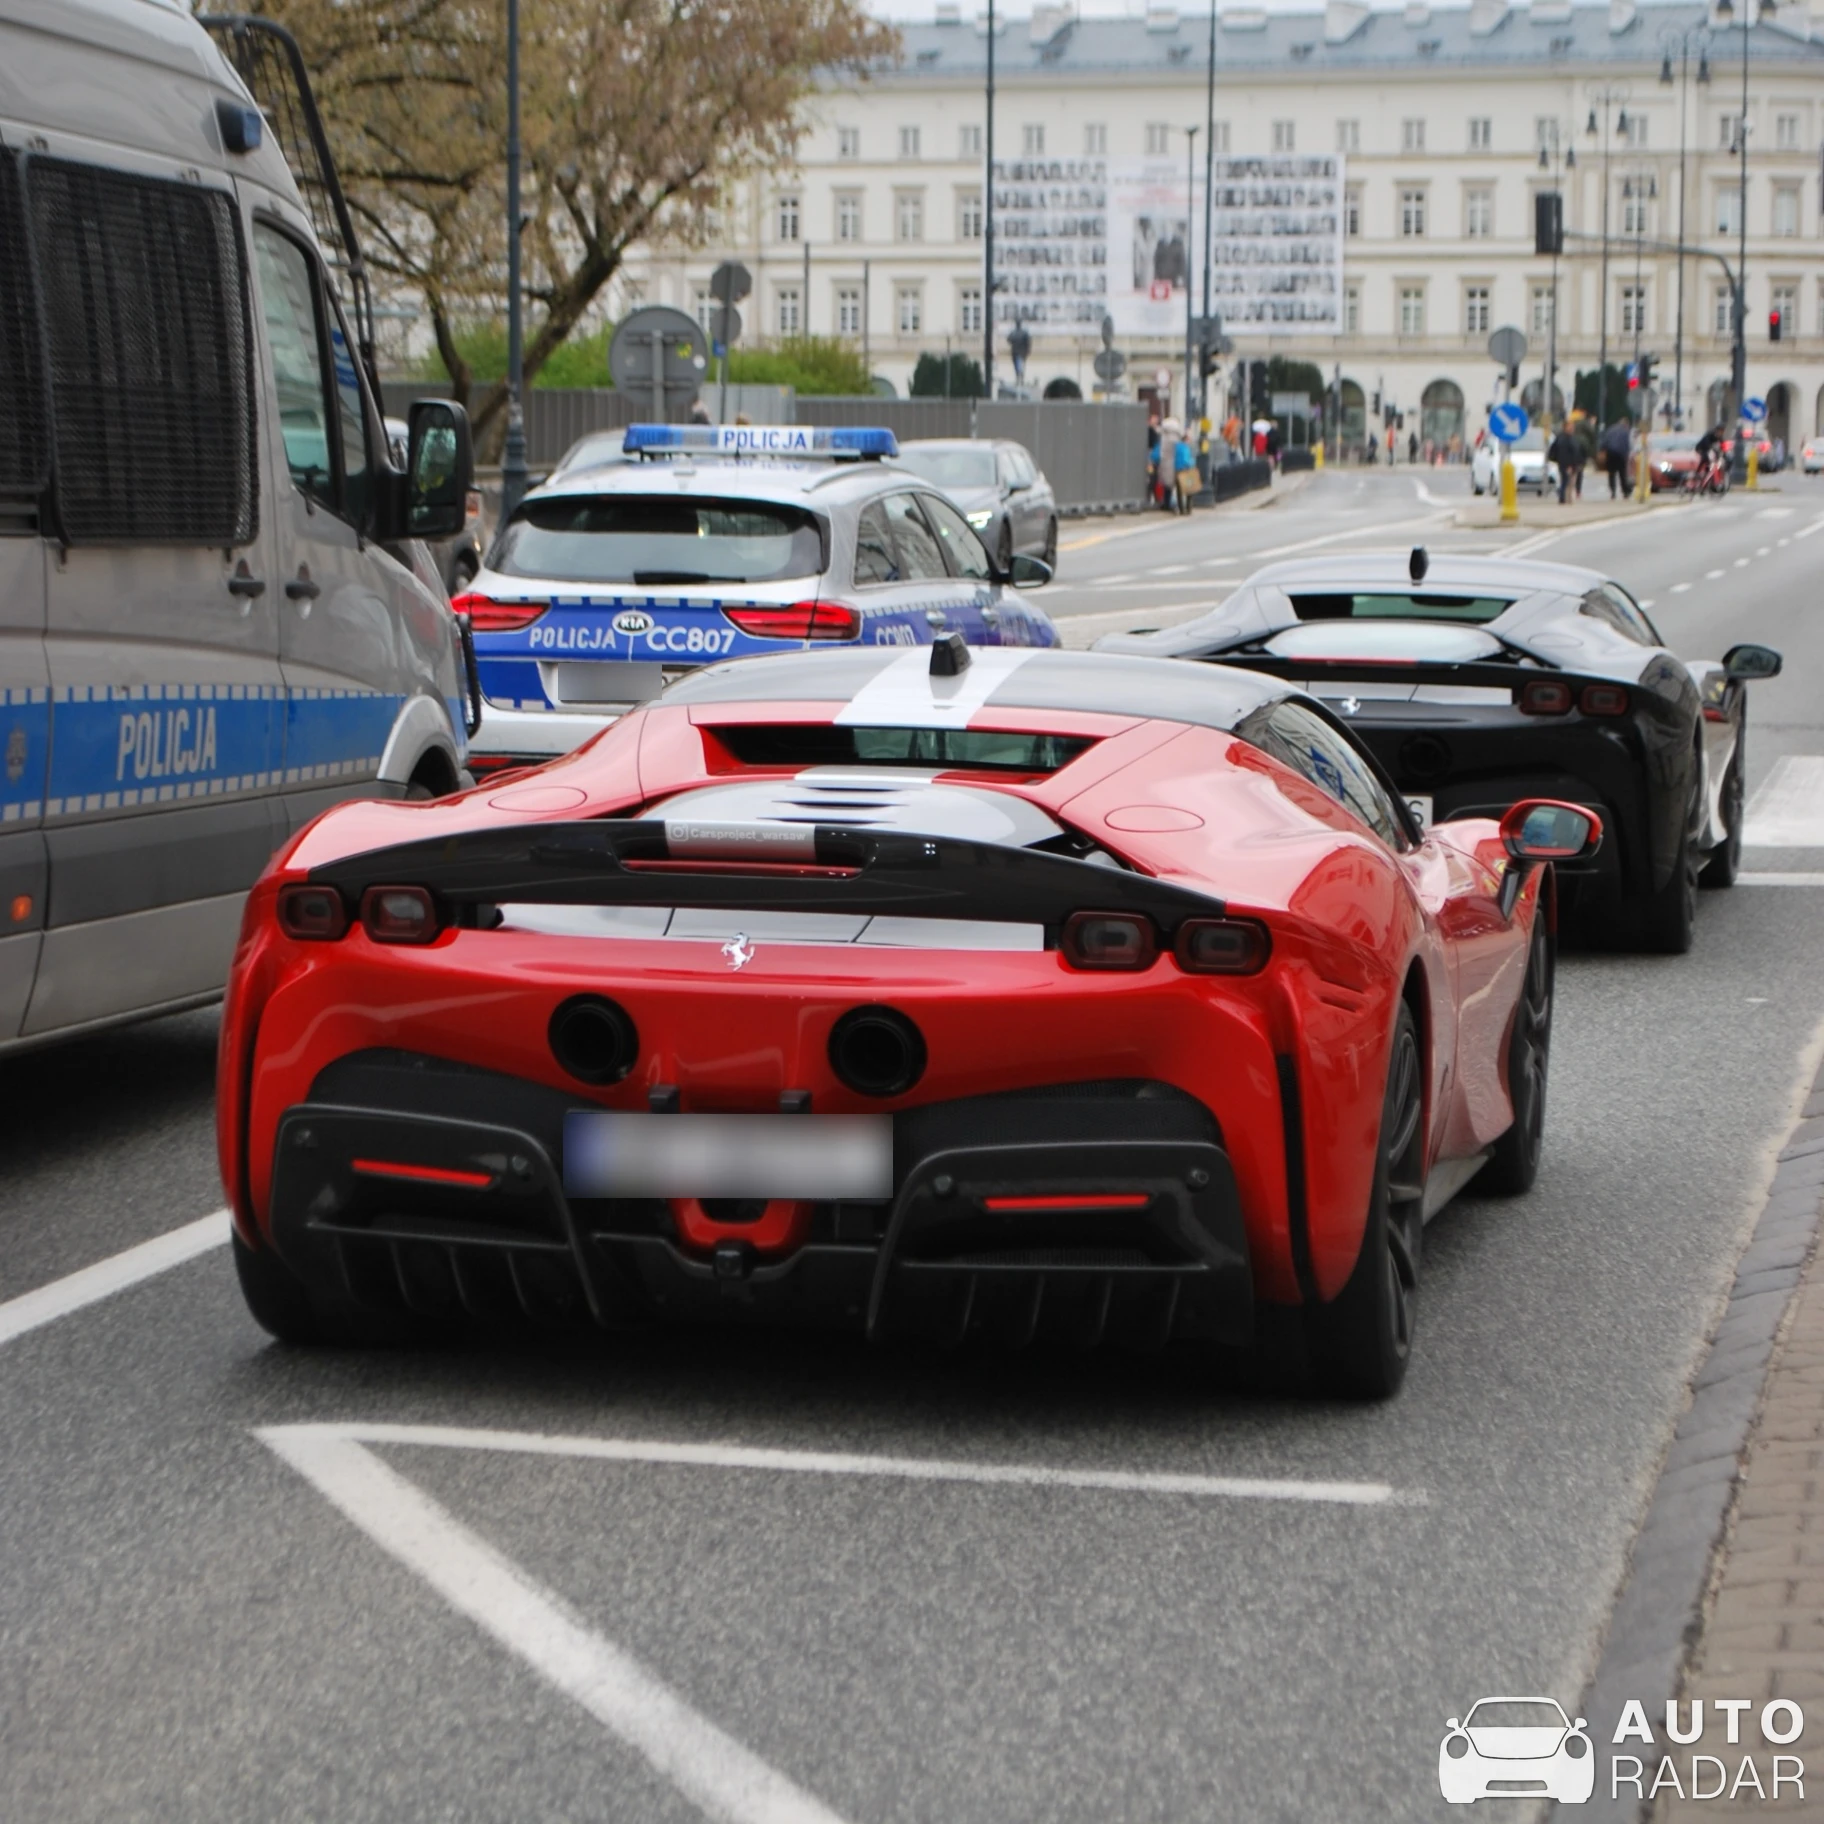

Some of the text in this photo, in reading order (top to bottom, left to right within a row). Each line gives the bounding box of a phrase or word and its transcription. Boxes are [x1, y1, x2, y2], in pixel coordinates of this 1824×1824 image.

[723, 430, 807, 449] POLICJA
[619, 616, 646, 629] KIA
[529, 626, 736, 653] POLICJA CC807
[116, 706, 217, 781] POLICJA
